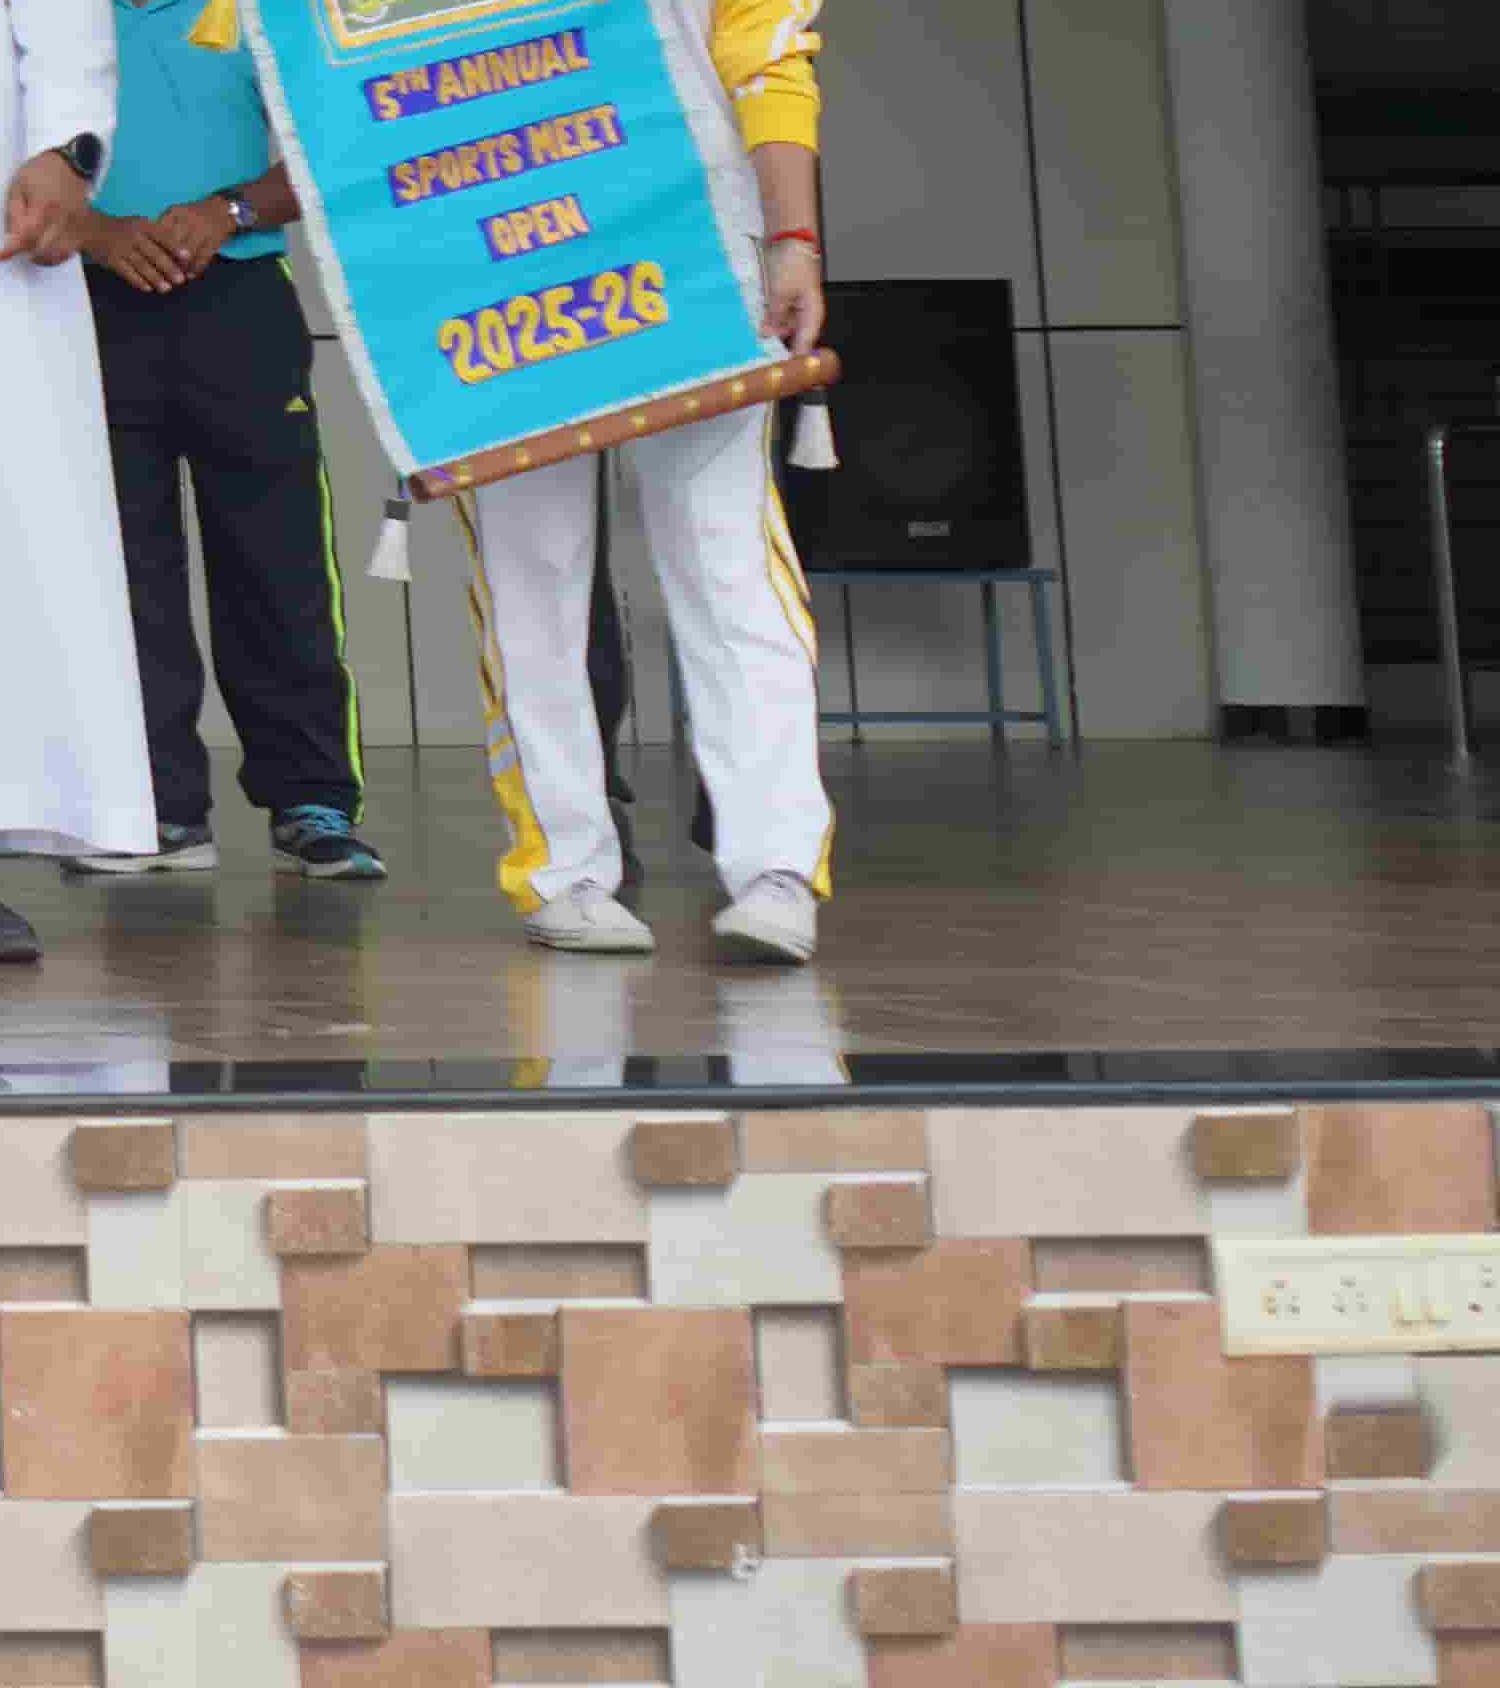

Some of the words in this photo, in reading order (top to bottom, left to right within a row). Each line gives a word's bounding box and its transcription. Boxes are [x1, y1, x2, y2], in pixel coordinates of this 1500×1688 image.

[434, 31, 591, 105] ANNUAL
[394, 133, 523, 201] SPORTS
[525, 104, 622, 166] MEET
[489, 195, 590, 255] OPEN
[436, 260, 669, 384] 2025-26
